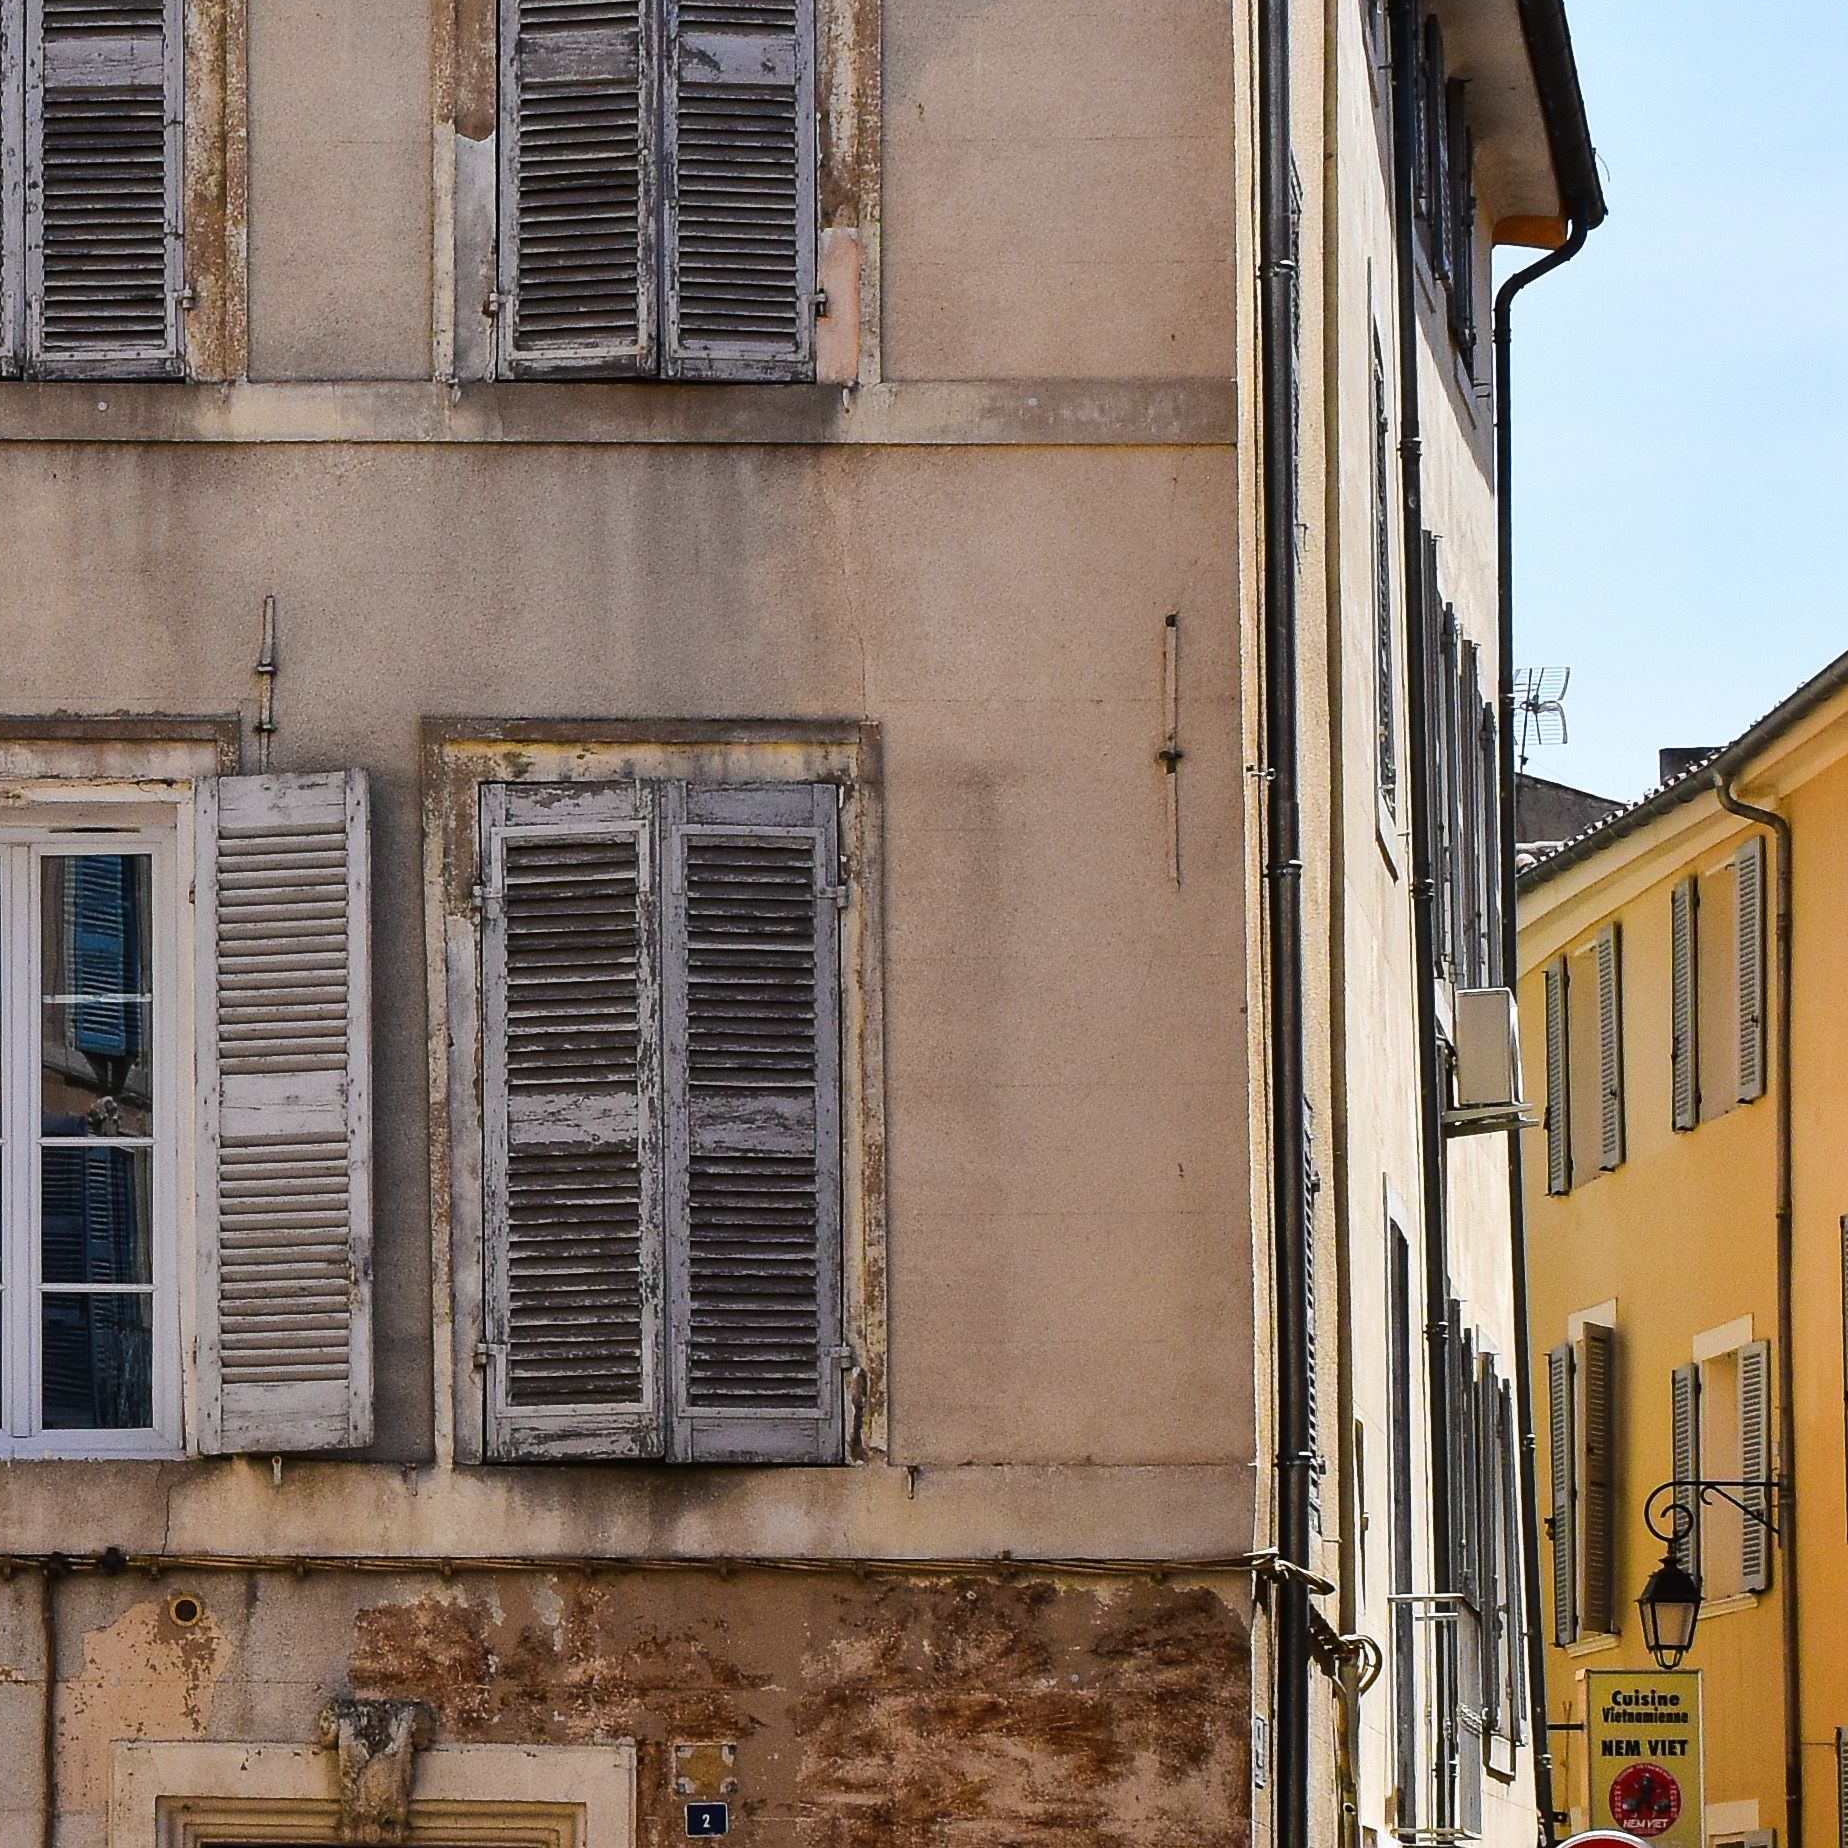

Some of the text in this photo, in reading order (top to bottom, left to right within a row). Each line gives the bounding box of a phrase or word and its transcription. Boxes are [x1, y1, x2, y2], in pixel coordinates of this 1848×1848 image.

[1611, 1688, 1681, 1707] Cuisine
[1601, 1706, 1689, 1724] Vietnamienne
[1601, 1739, 1689, 1757] NEM VIET
[702, 1813, 711, 1828] 2
